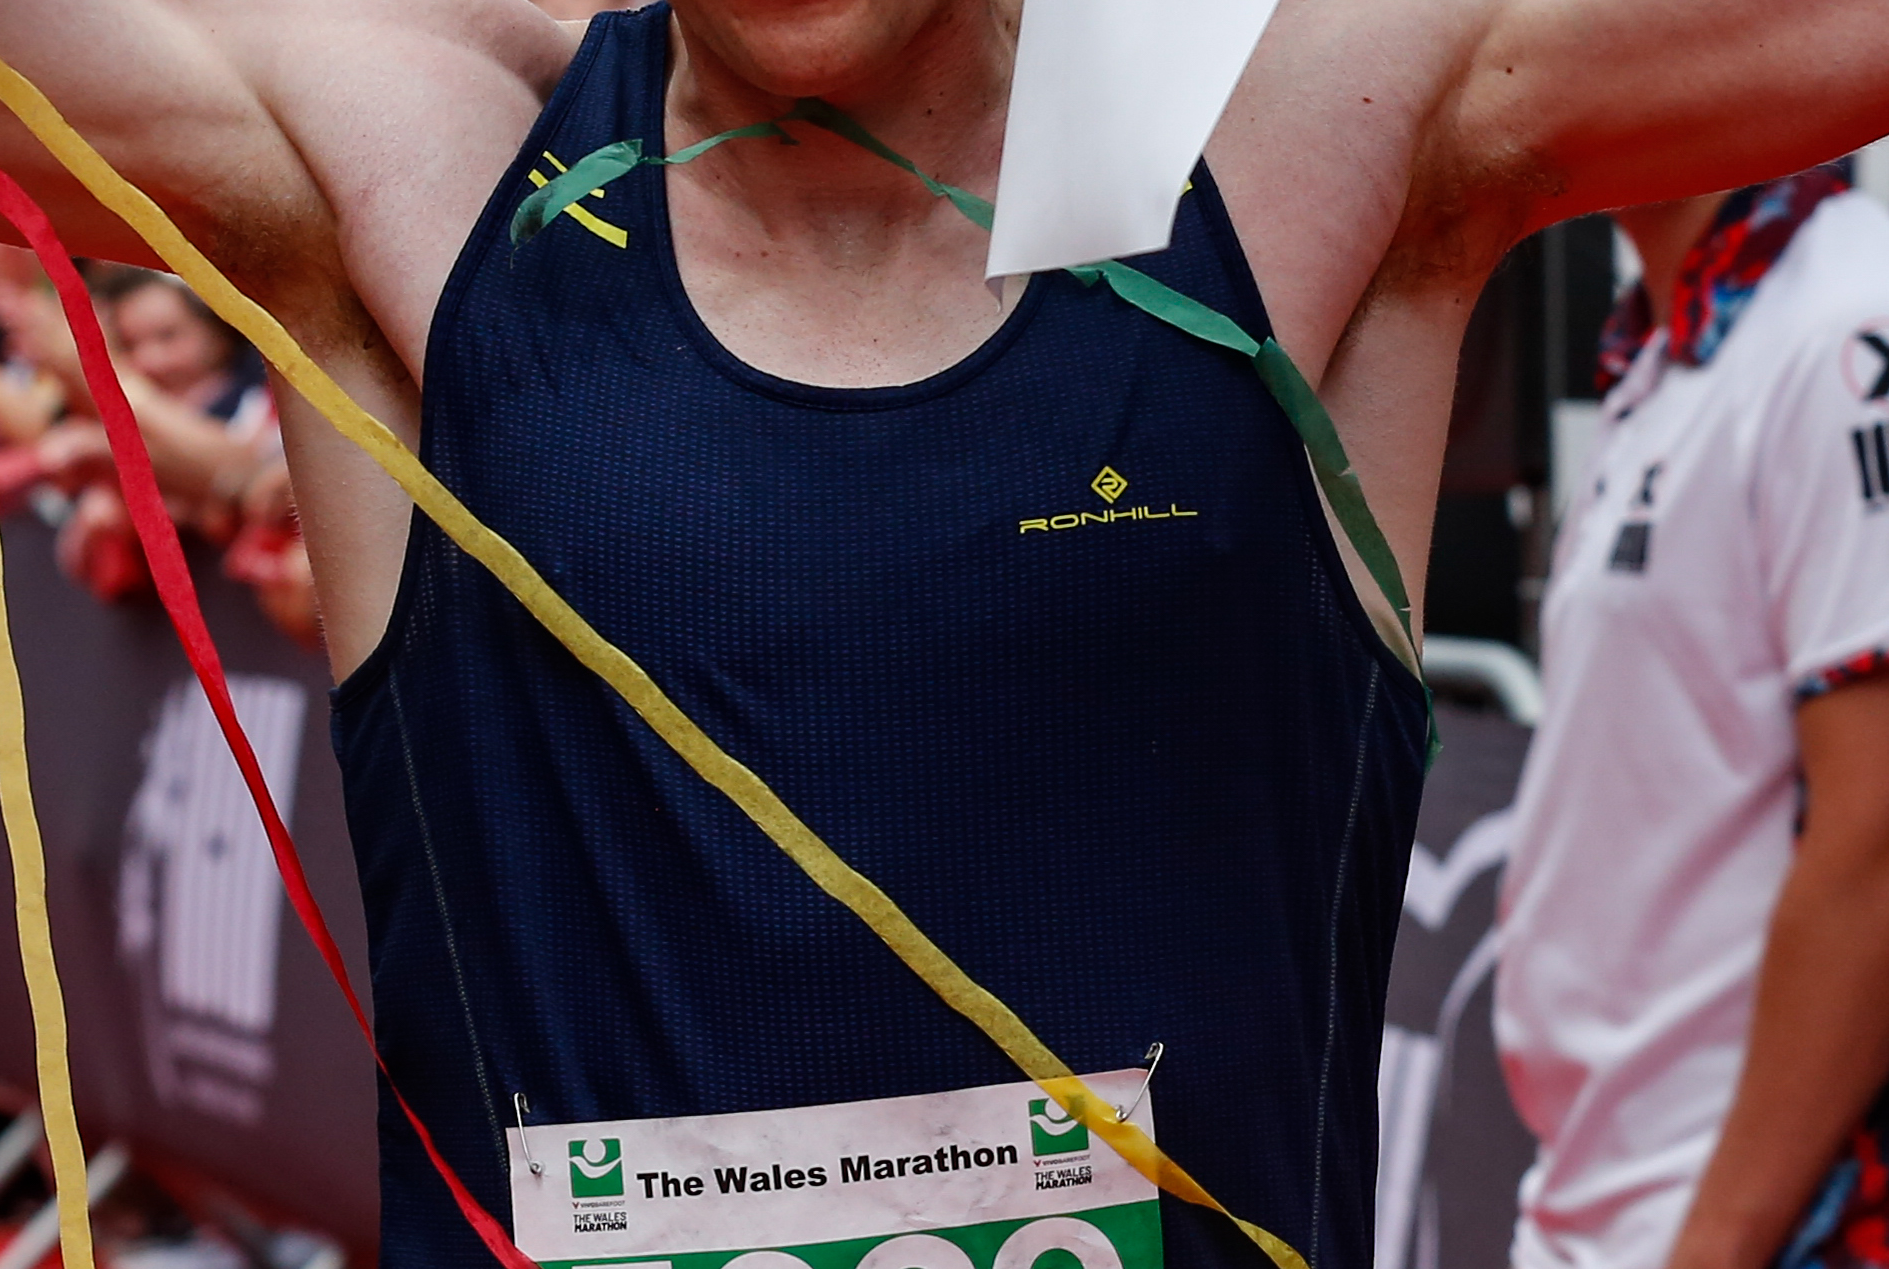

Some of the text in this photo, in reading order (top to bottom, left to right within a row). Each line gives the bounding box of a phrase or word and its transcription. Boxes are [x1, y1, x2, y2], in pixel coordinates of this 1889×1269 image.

[1019, 503, 1198, 534] RONHILL
[637, 1143, 1018, 1199] The Wales Marathon
[1035, 1166, 1092, 1181] THE WALES
[1035, 1175, 1092, 1190] MARATHON
[573, 1211, 627, 1223] THE WALES
[574, 1221, 627, 1233] MARATHON
